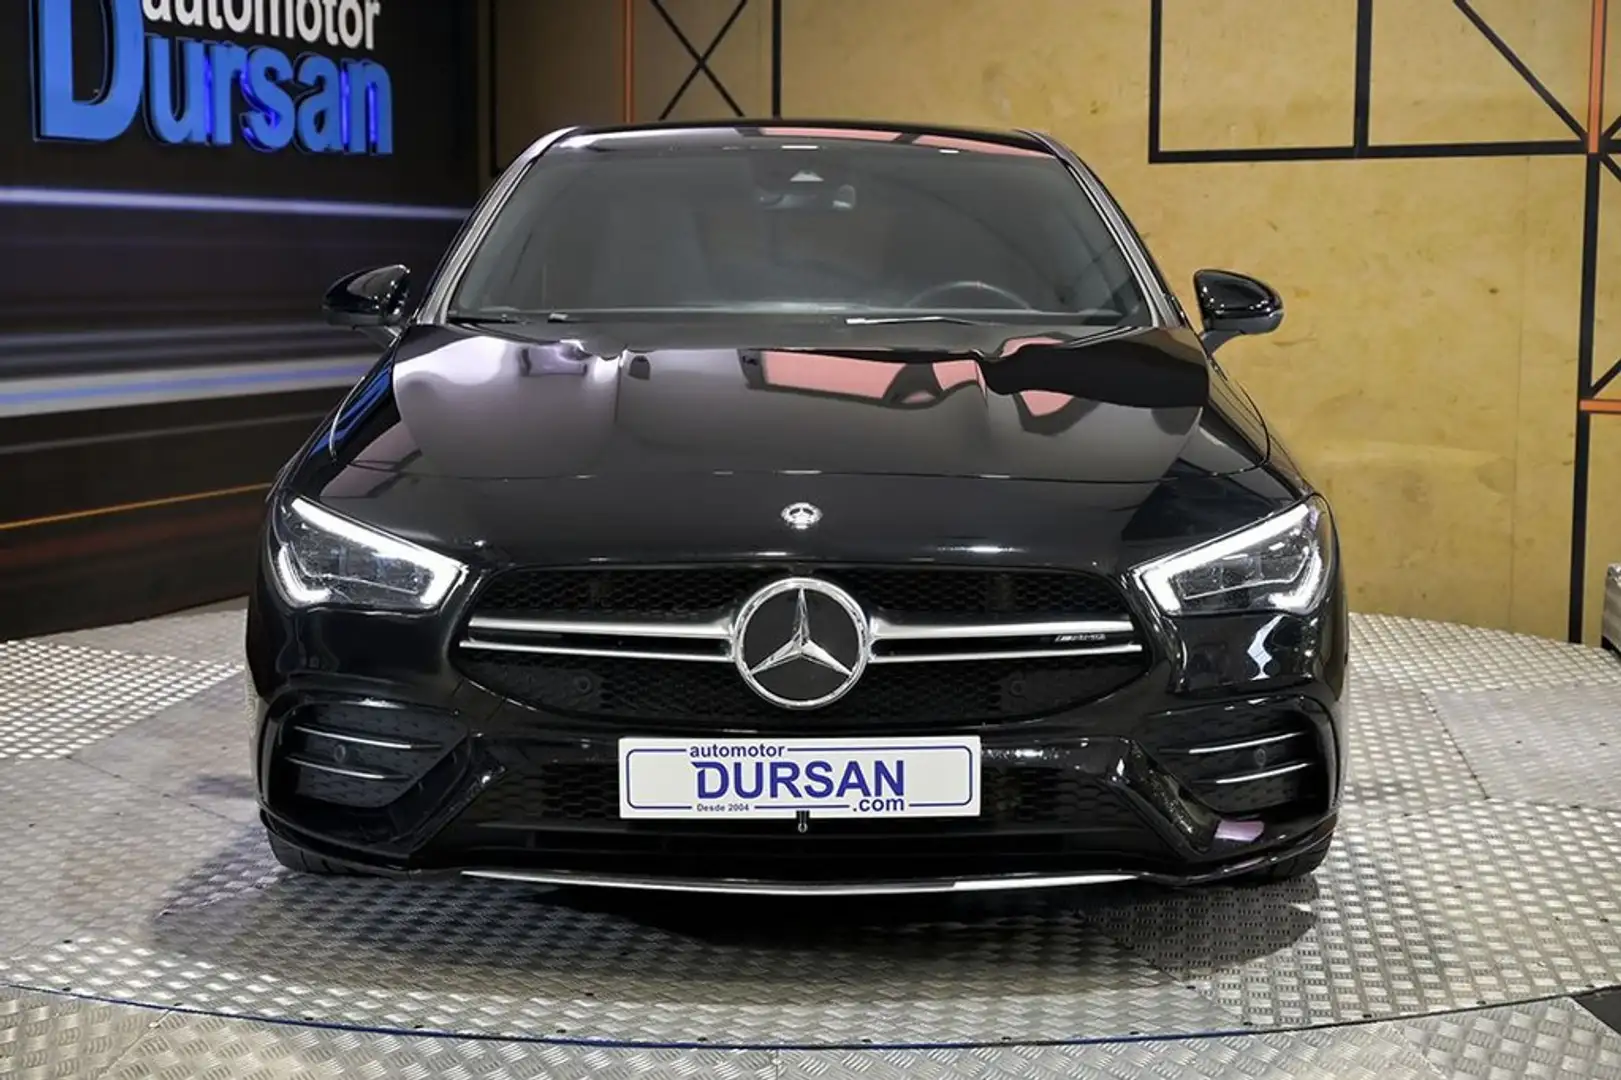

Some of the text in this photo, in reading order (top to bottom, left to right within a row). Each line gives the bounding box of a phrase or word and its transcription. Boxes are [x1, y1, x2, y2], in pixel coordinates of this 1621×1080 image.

[32, 0, 394, 155] Dursan
[689, 744, 785, 758] automotor
[690, 760, 905, 799] DURSAN
[696, 803, 750, 812] Desde 2004
[852, 798, 905, 812] .com
